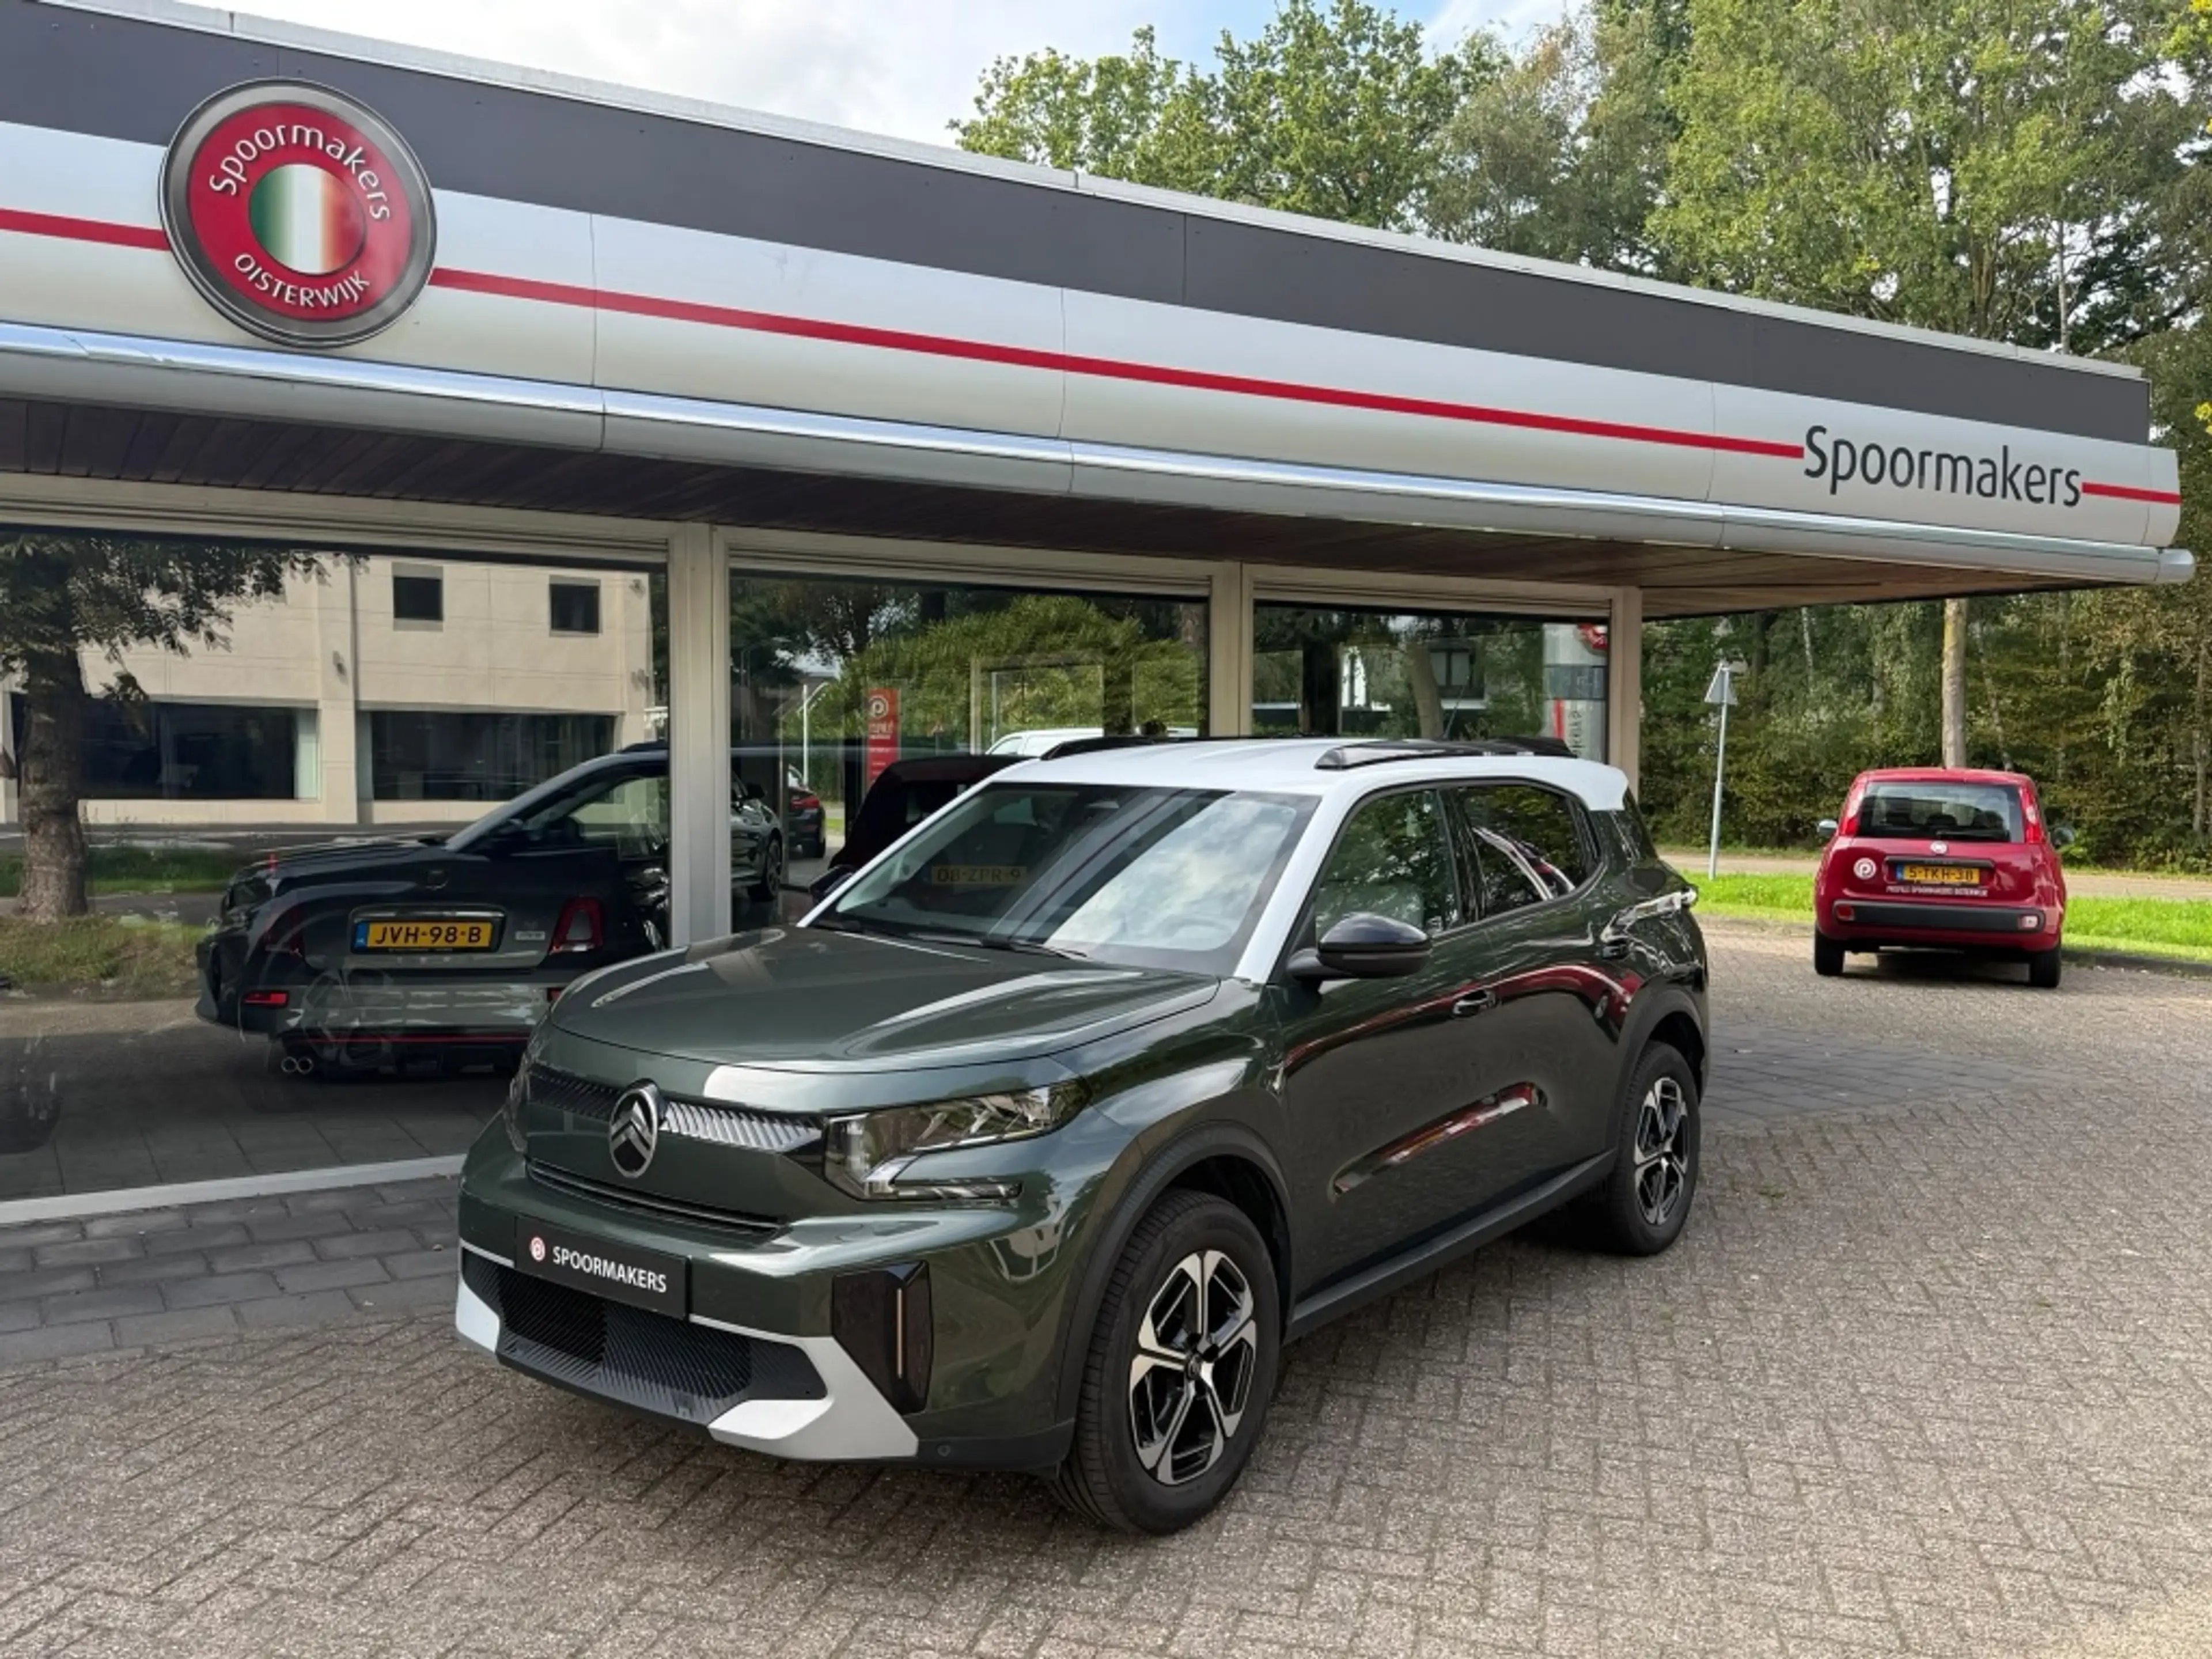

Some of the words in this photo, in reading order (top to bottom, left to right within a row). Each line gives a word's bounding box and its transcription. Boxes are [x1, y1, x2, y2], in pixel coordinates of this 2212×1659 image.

[209, 124, 390, 221] Spoormakers
[234, 253, 370, 308] OISTERWIJK
[1804, 425, 2081, 507] Spoormakers
[375, 926, 482, 945] JVH-98-B
[552, 1245, 667, 1293] SPOORMAKERS
